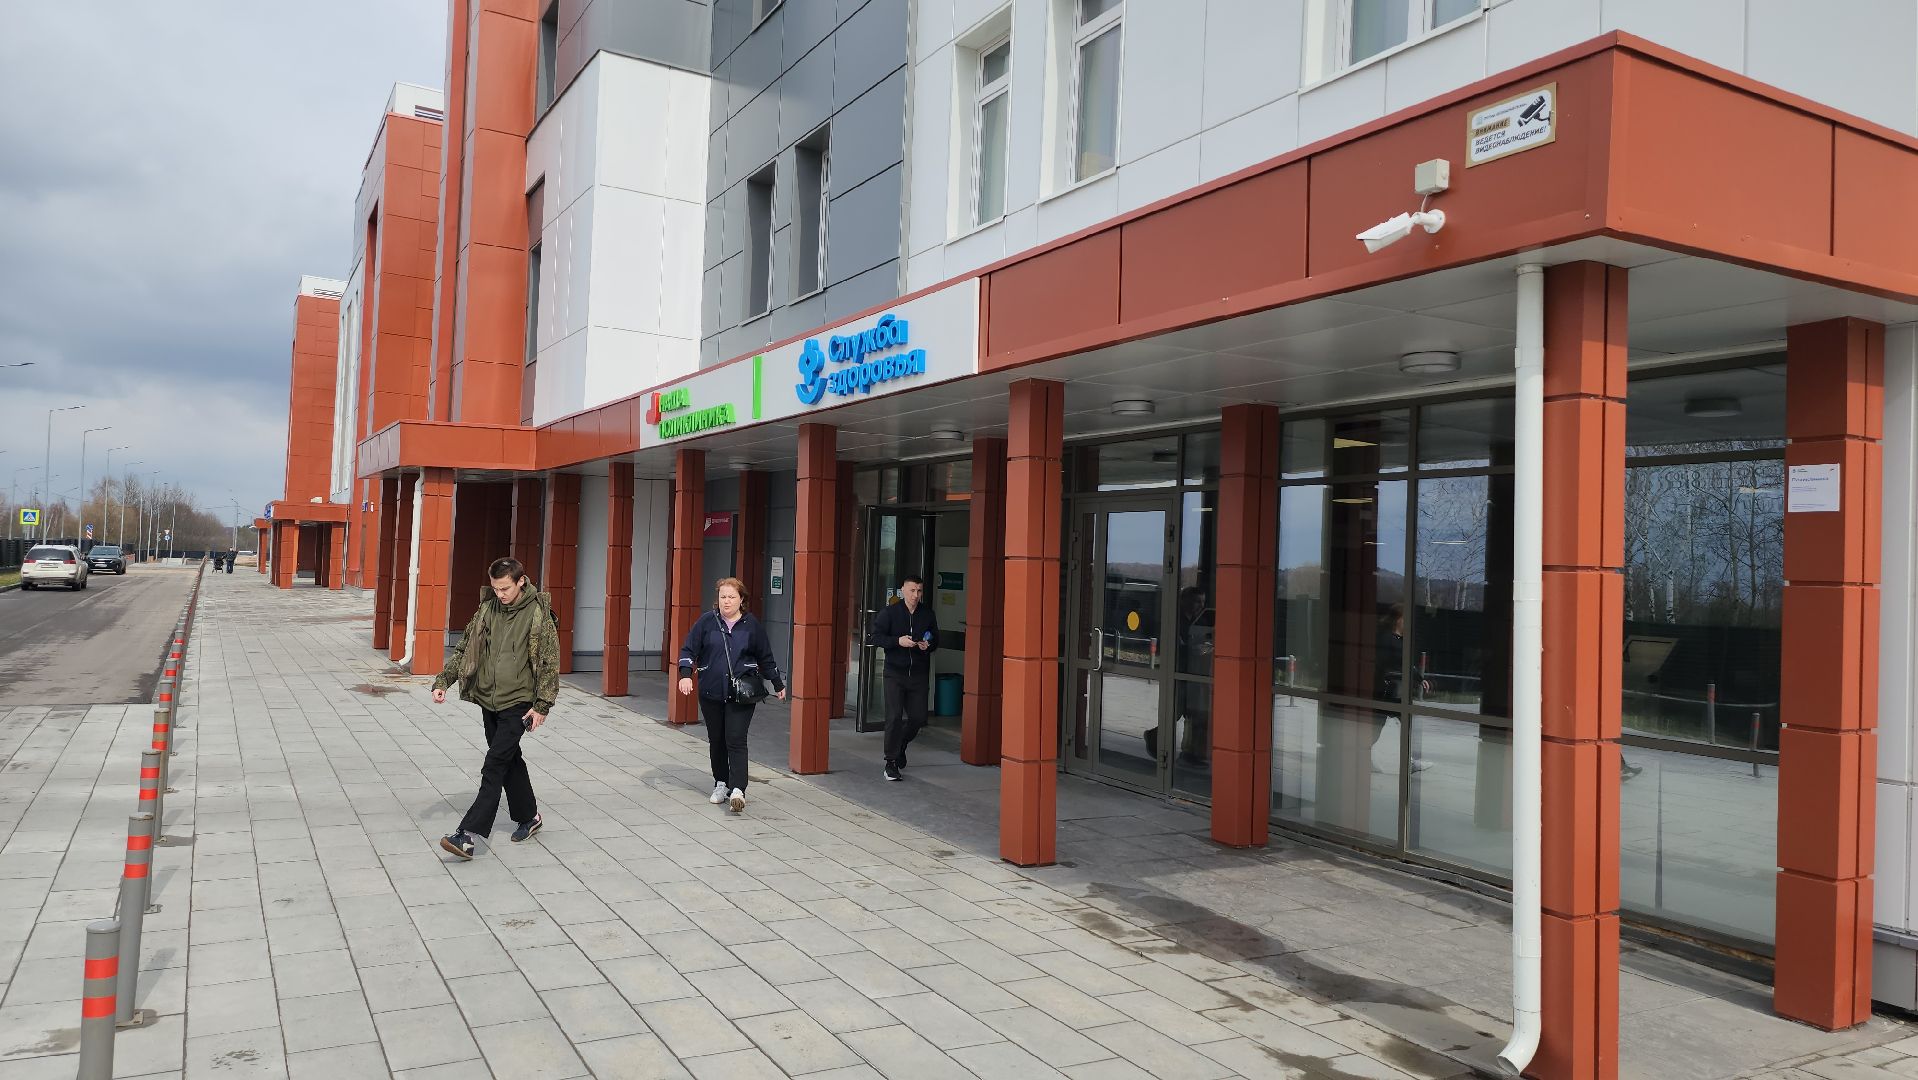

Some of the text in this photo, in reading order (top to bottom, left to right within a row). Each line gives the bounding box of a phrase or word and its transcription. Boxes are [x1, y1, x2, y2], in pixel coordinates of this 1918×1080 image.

[1475, 130, 1506, 146] ВЕДЕТСЯ
[1475, 126, 1547, 154] ВИДЕОНАБЛЮДЕНИЕ!
[829, 313, 909, 363] Служба
[828, 349, 926, 396] здоровья
